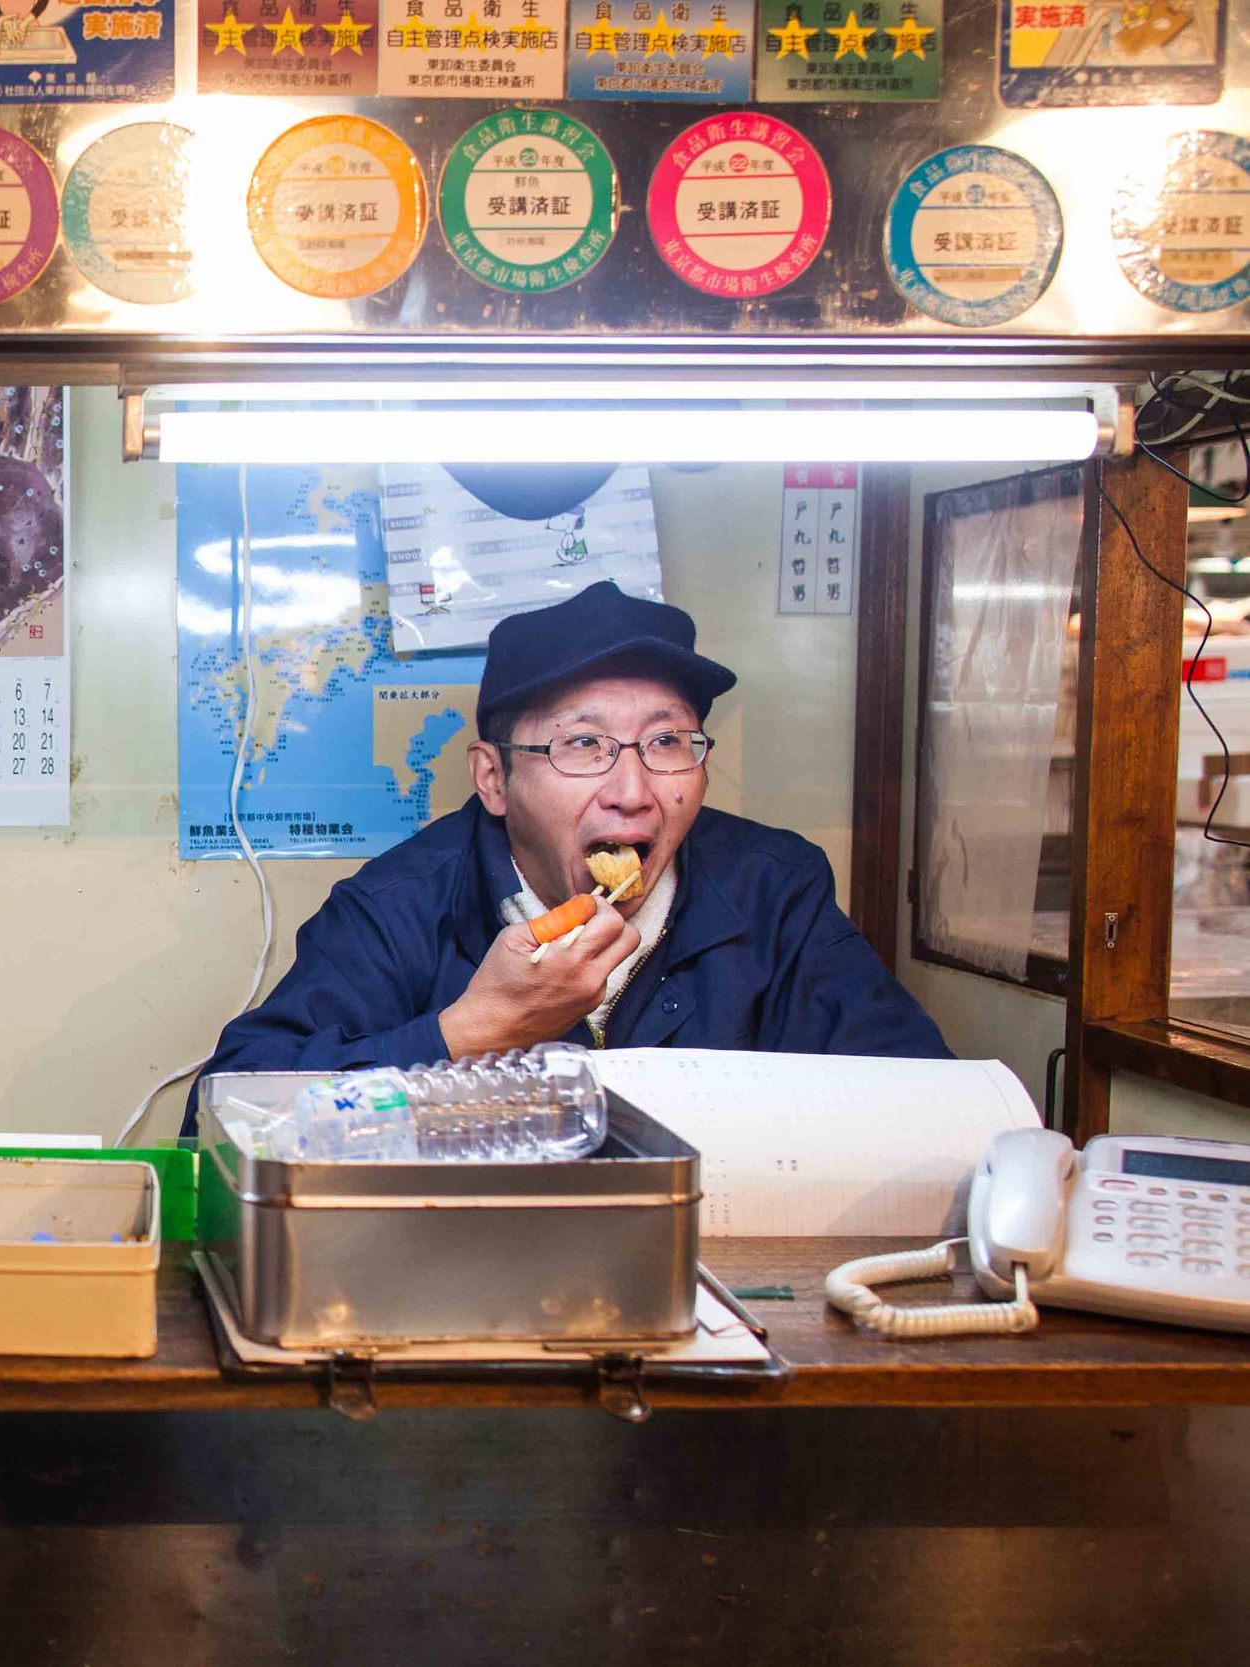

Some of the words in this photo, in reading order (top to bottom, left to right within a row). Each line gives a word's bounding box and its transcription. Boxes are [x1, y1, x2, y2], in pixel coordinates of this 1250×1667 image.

[406, 0, 540, 17] 食品衛生
[596, 1, 728, 21] 食品衛生
[786, 1, 918, 21] 食品衛生
[1015, 5, 1086, 28] 実施済
[83, 11, 162, 39] 実施済
[203, 28, 374, 48] 自主管理点検実施店
[387, 30, 558, 49] 自主管理点検実施店
[575, 34, 746, 53] 自主管理点検実施店
[765, 34, 936, 53] 自主管理点検実施店
[427, 59, 516, 72] 東卸衛生委員会
[408, 75, 535, 88] 東京都市場衛生検査所
[463, 113, 595, 161] 食品衛生講習会
[672, 119, 805, 170] 食品衛生講習会
[295, 203, 378, 222] 受講済証
[488, 196, 571, 216] 受講済証
[697, 200, 780, 221] 受講済証
[934, 232, 1018, 252] 受講済証
[663, 233, 817, 293] 東京都市場衛生検査所
[15, 683, 22, 700] 6
[44, 683, 51, 700] 7
[378, 689, 440, 700] 関東拡大部分
[13, 708, 26, 725] 13
[42, 708, 54, 725] 14
[12, 733, 26, 750] 20
[40, 733, 53, 750] 21
[12, 758, 26, 775] 27
[41, 757, 55, 774] 28
[289, 823, 354, 836] 特種物業会
